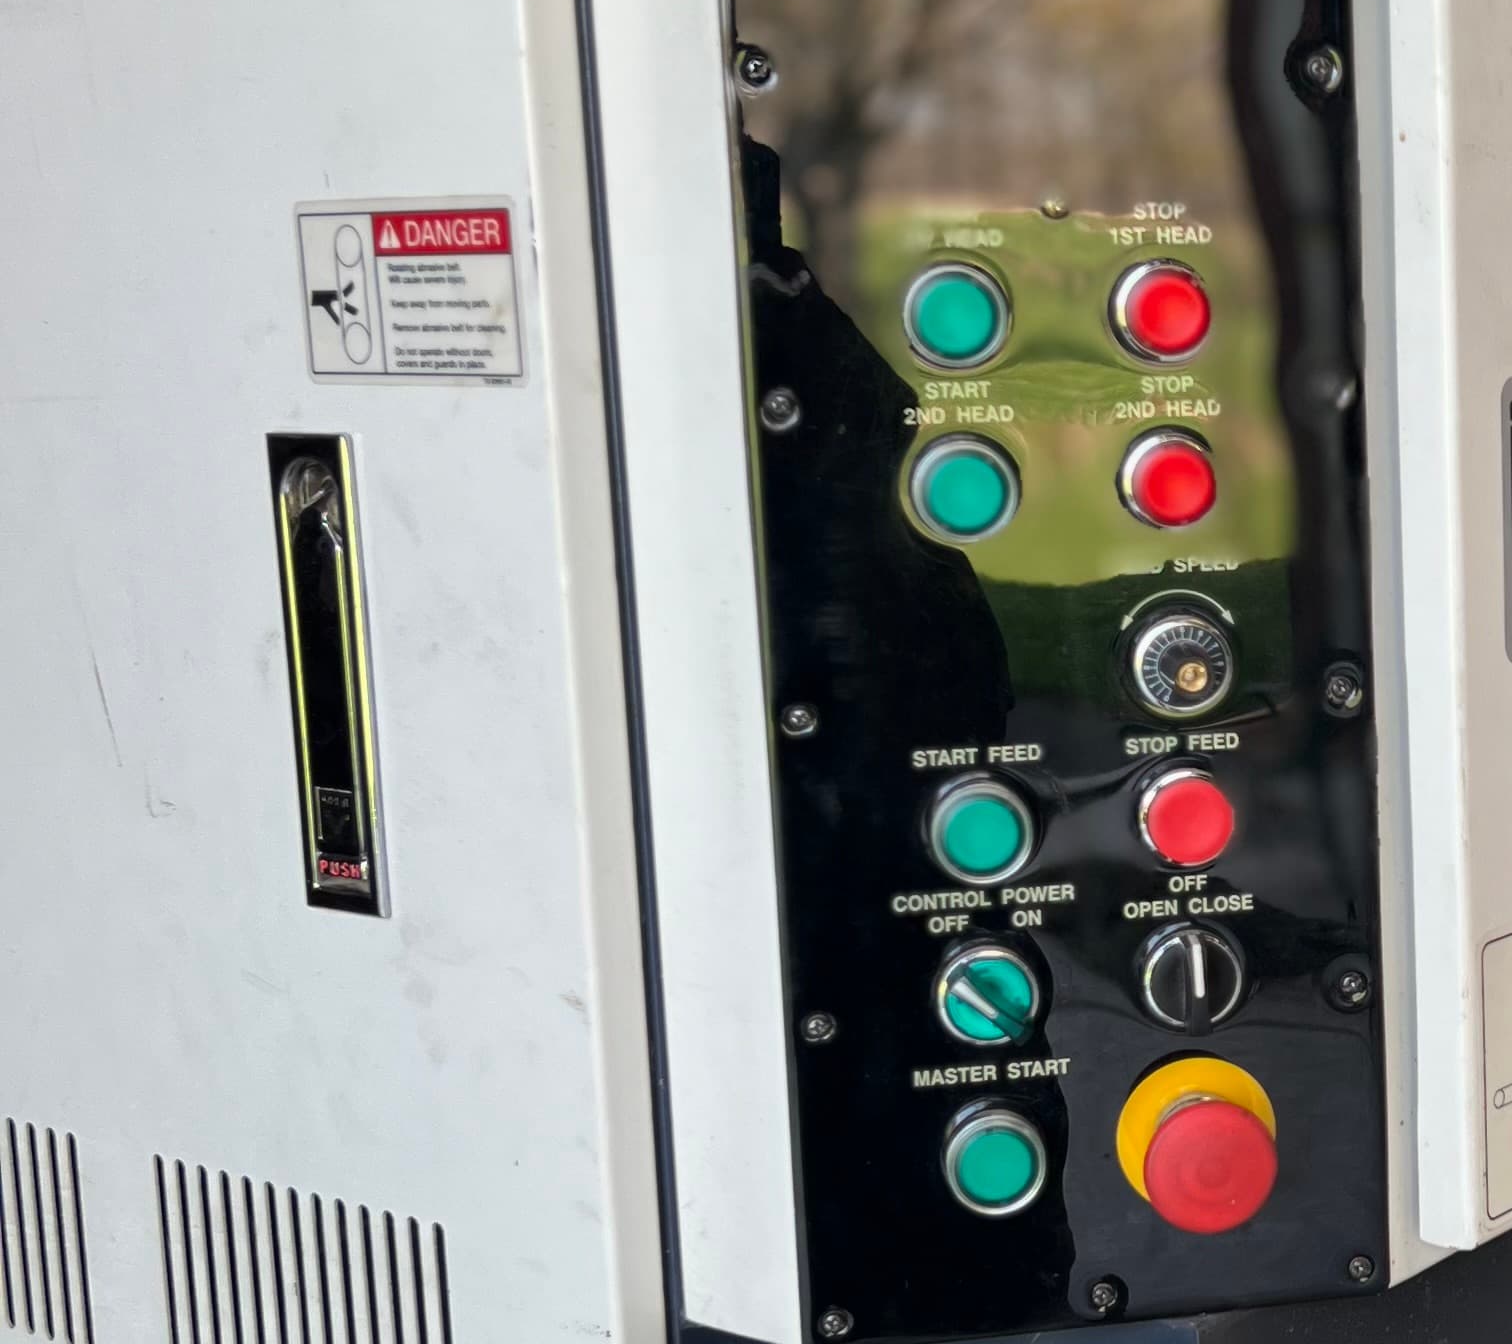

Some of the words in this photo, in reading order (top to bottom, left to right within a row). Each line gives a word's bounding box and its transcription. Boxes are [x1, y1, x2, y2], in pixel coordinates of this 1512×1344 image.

[1133, 202, 1186, 220] STOP
[404, 218, 501, 247] DANGER
[1110, 228, 1147, 244] 1ST
[1156, 226, 1213, 244] HEAD
[925, 381, 991, 399] START
[1141, 376, 1194, 394] STOP
[903, 408, 946, 425] 2ND
[957, 406, 1014, 424] HEAD
[1115, 403, 1156, 420] 2ND
[1166, 399, 1221, 418] HEAD
[1125, 736, 1178, 755] STOP
[1188, 733, 1240, 751] FEED
[912, 748, 978, 768] START
[989, 744, 1041, 763] FEED
[319, 859, 360, 879] PUSH
[1169, 874, 1207, 893] OFF
[892, 891, 990, 913] CONTROL
[1002, 884, 1075, 905] POWER
[1123, 899, 1178, 919] OPEN
[1188, 894, 1254, 914] CLOSE
[928, 915, 969, 934] OFF
[1012, 909, 1042, 927] ON
[914, 1064, 997, 1087] MASTER
[1007, 1058, 1071, 1078] START
